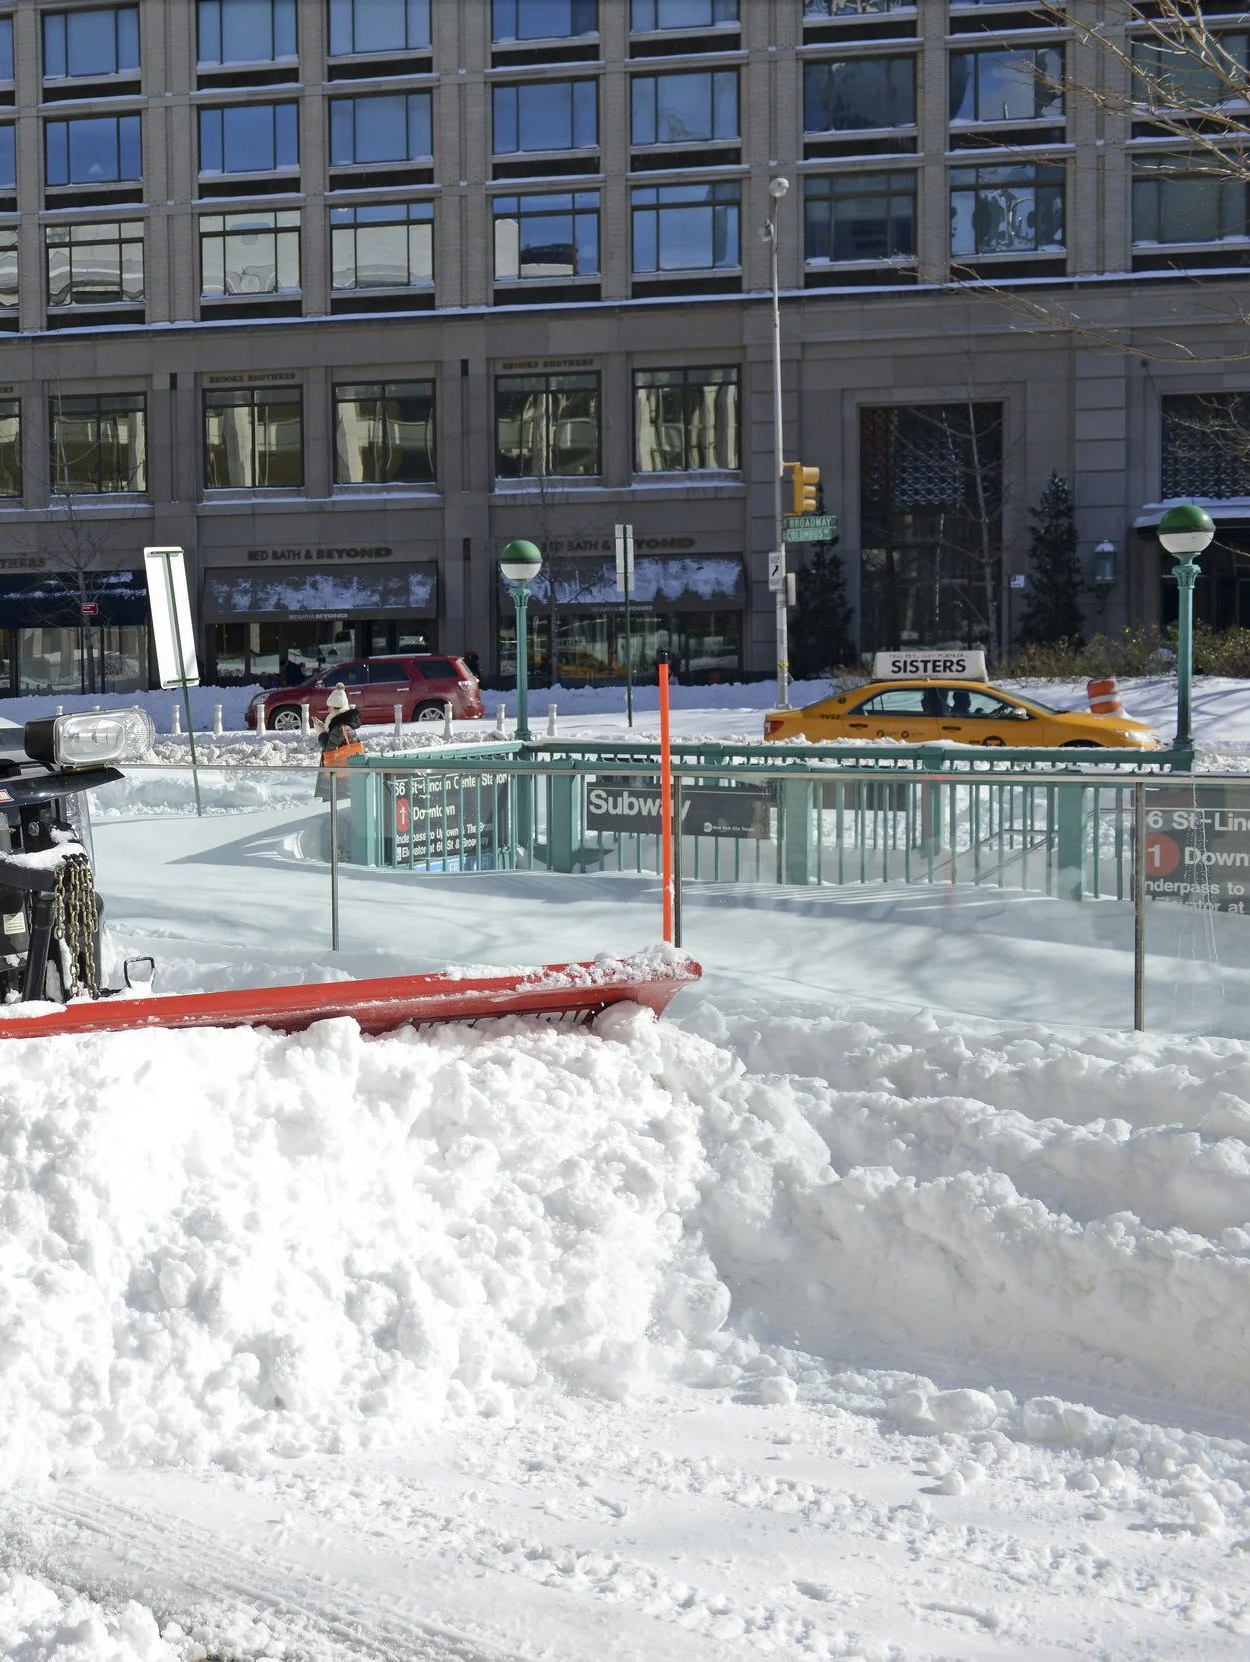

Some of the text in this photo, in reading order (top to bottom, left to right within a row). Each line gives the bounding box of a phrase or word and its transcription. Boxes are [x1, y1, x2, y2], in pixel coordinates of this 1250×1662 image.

[543, 358, 595, 368] BROTHERS
[209, 372, 297, 384] BROOKS BROTHERS
[789, 518, 831, 528] BROADWAY
[787, 529, 823, 540] COLUMBUS
[601, 540, 611, 550] &
[247, 547, 393, 561] BED BATH & BEYOND
[891, 659, 967, 674] SISTERS
[589, 789, 692, 821] Subwy
[1147, 844, 1250, 868] 1 Down
[1145, 879, 1245, 896] nderpass to
[1228, 901, 1245, 914] at
